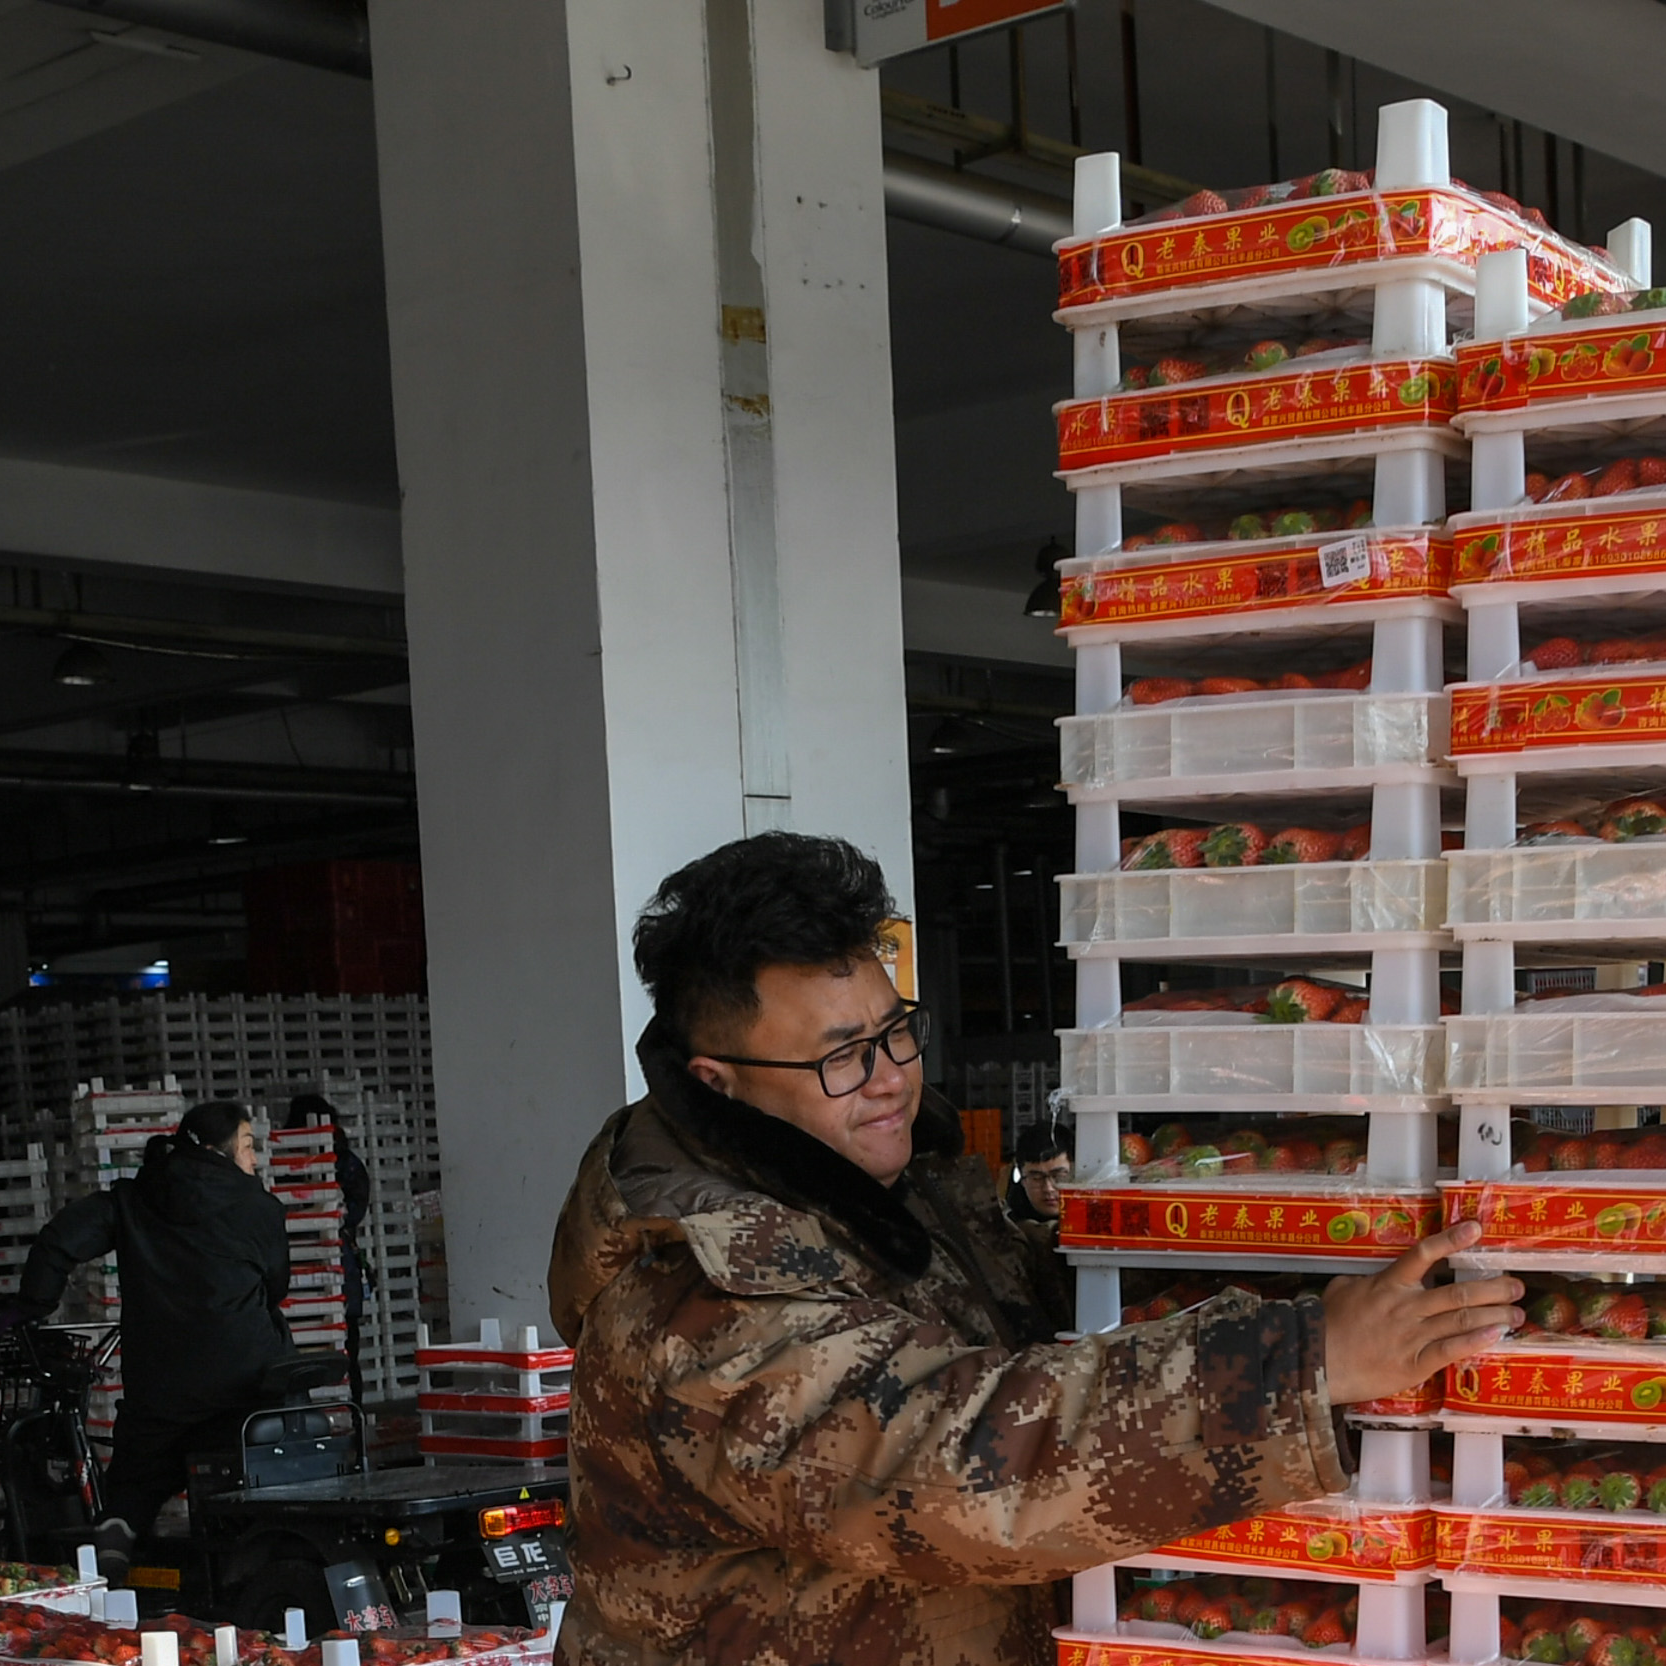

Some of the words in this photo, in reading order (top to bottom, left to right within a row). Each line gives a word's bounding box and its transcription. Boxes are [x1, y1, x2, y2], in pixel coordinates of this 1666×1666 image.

[1121, 242, 1145, 278] Q
[1155, 223, 1280, 260] 老秦果业
[1226, 390, 1251, 428] Q
[1165, 1203, 1190, 1239] Q
[1199, 1204, 1321, 1230] 老秦果业
[1455, 1366, 1480, 1401] Q
[1490, 1369, 1624, 1393] 老秦果业
